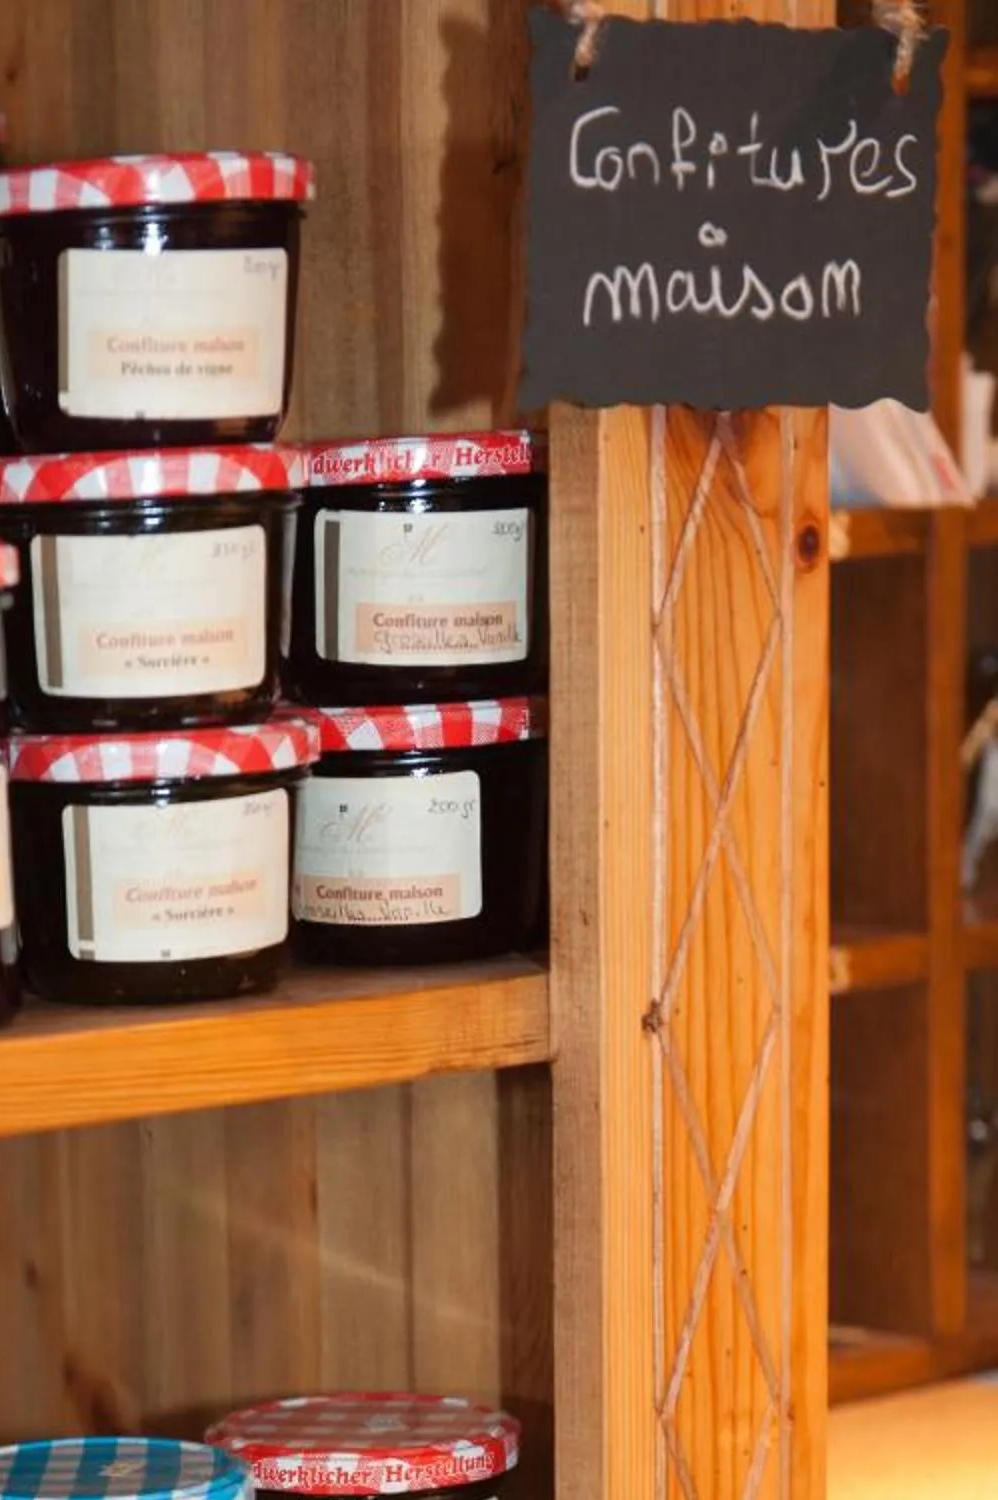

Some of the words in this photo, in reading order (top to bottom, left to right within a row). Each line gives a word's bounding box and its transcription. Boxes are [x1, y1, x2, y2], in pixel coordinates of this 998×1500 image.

[569, 105, 918, 200] Confitures
[372, 611, 448, 628] Confiture
[453, 612, 503, 628] maison
[95, 632, 176, 650] Confiture
[315, 883, 383, 901] Confiture
[389, 884, 444, 899] maison
[252, 1459, 372, 1486] dwerklicher
